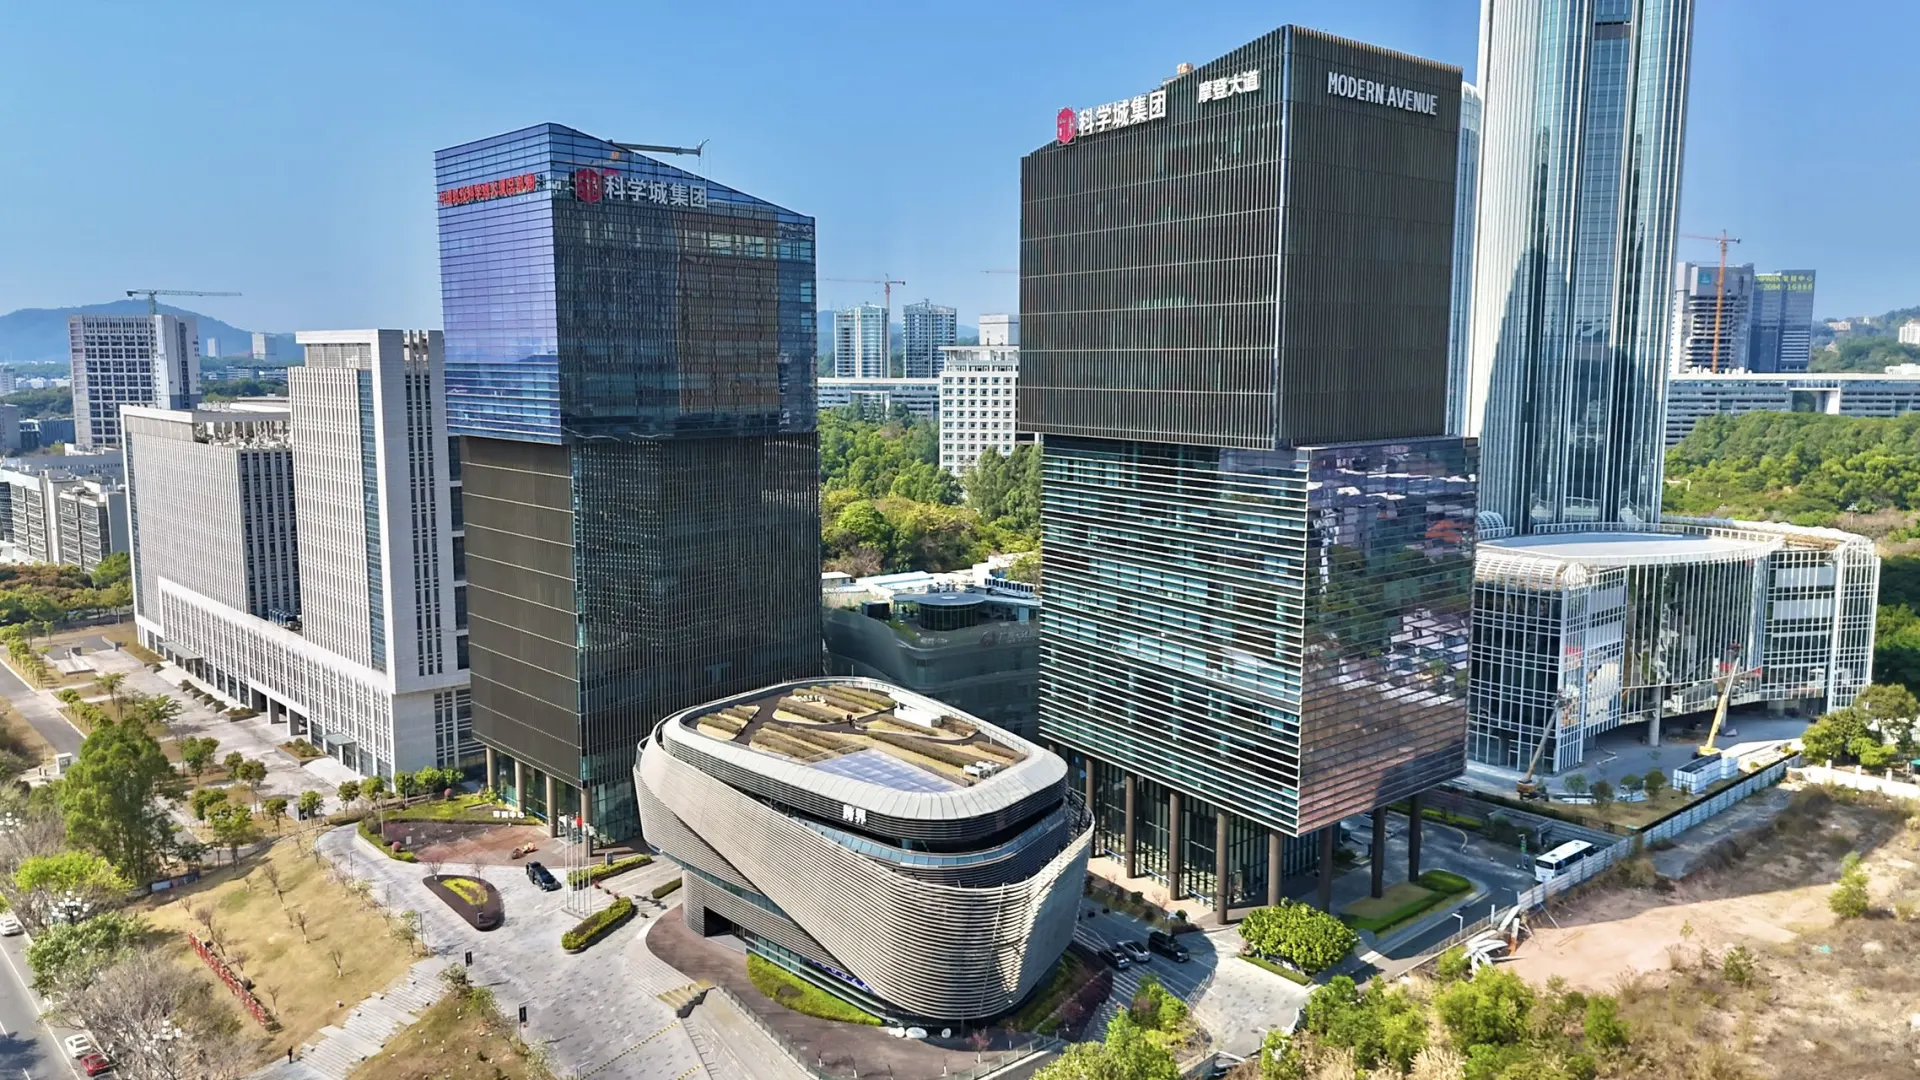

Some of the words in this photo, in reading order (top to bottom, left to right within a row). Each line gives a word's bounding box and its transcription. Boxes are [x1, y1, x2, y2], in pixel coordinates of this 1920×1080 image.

[1198, 70, 1259, 104] 摩登大道
[1327, 71, 1385, 105] MODERN
[1386, 86, 1438, 116] AVENUE
[1078, 90, 1167, 137] 科学城集团
[605, 175, 708, 209] 科学城集团
